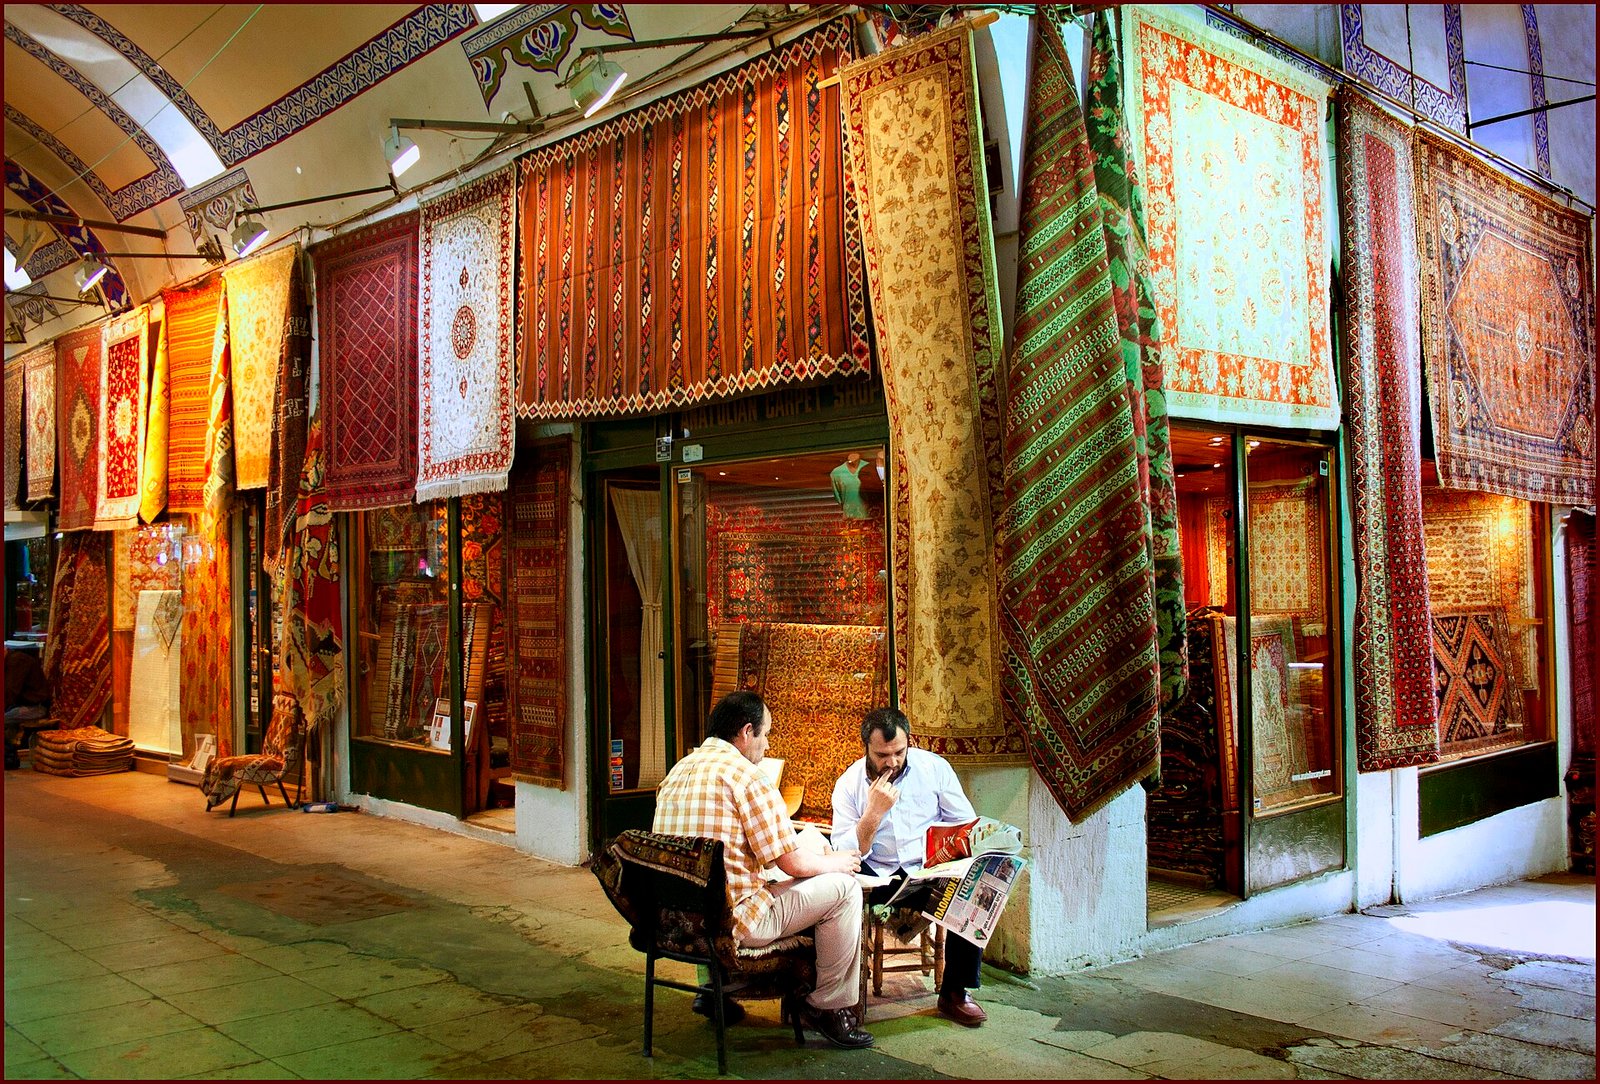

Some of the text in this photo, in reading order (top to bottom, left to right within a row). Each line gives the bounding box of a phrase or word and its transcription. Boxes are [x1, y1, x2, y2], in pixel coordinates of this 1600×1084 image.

[765, 387, 822, 418] CARPET
[833, 379, 880, 409] SHOP
[934, 881, 958, 920] KONVOYU
